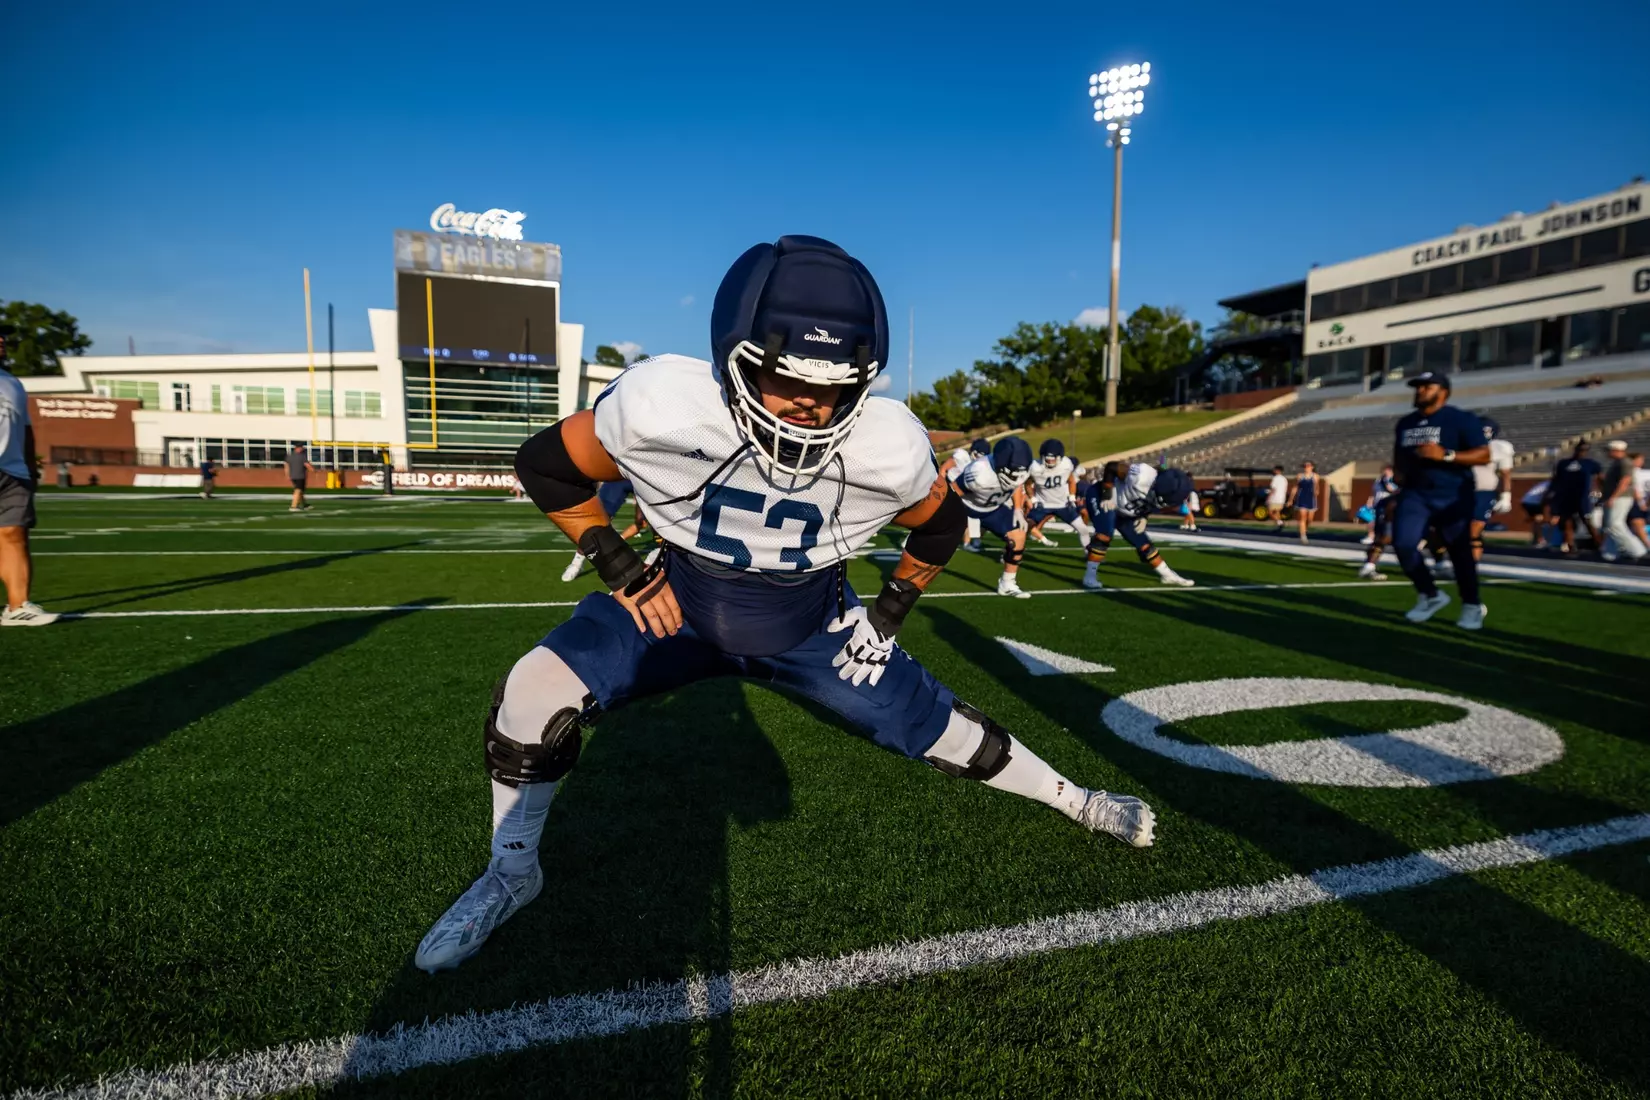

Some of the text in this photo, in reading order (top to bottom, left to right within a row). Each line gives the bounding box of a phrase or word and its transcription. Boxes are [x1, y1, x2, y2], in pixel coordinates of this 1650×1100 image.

[1412, 194, 1642, 265] COACH PAUL JOHNSON
[441, 242, 516, 270] EAGLES
[804, 334, 842, 345] GUARDIAN
[809, 360, 829, 369] VICIS
[391, 473, 430, 486] FIELD
[432, 473, 453, 486] OF
[456, 474, 515, 487] DREAMS
[1044, 475, 1062, 489] 48
[1101, 676, 1565, 787] 0
